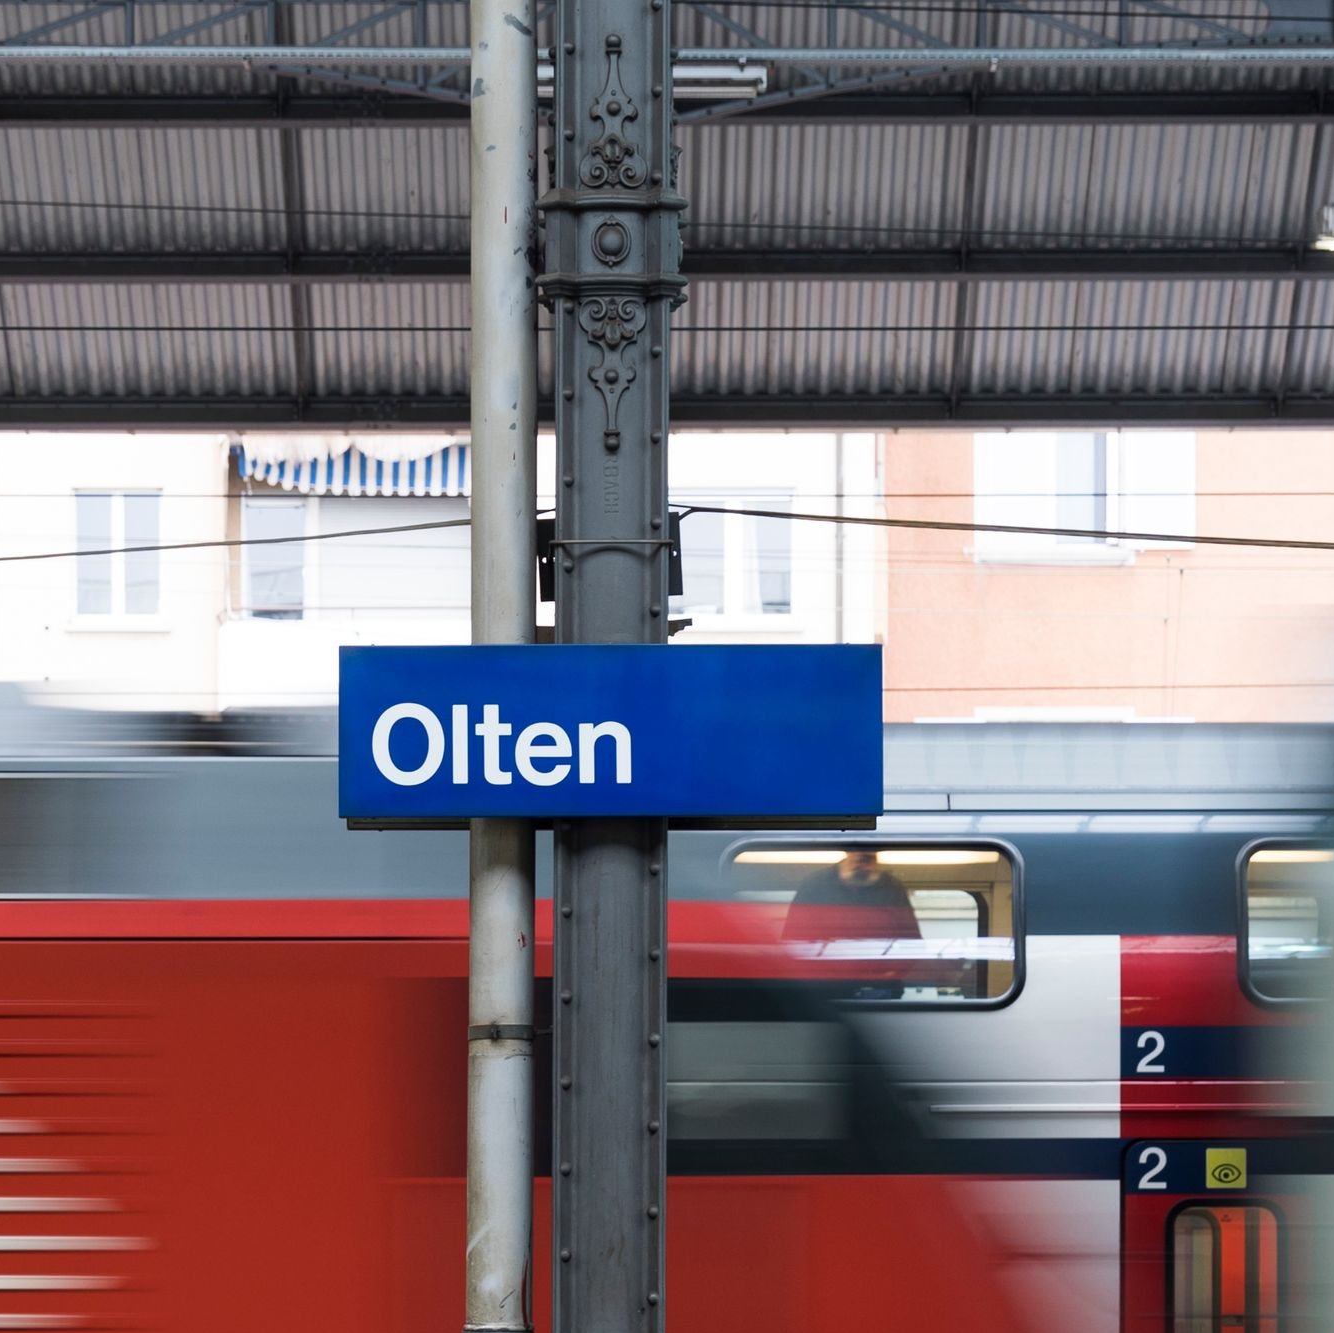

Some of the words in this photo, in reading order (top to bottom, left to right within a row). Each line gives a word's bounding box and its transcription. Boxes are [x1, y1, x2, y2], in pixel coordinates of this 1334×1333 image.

[371, 702, 632, 787] Olten
[1135, 1030, 1166, 1074] 2
[1137, 1146, 1168, 1190] 2
